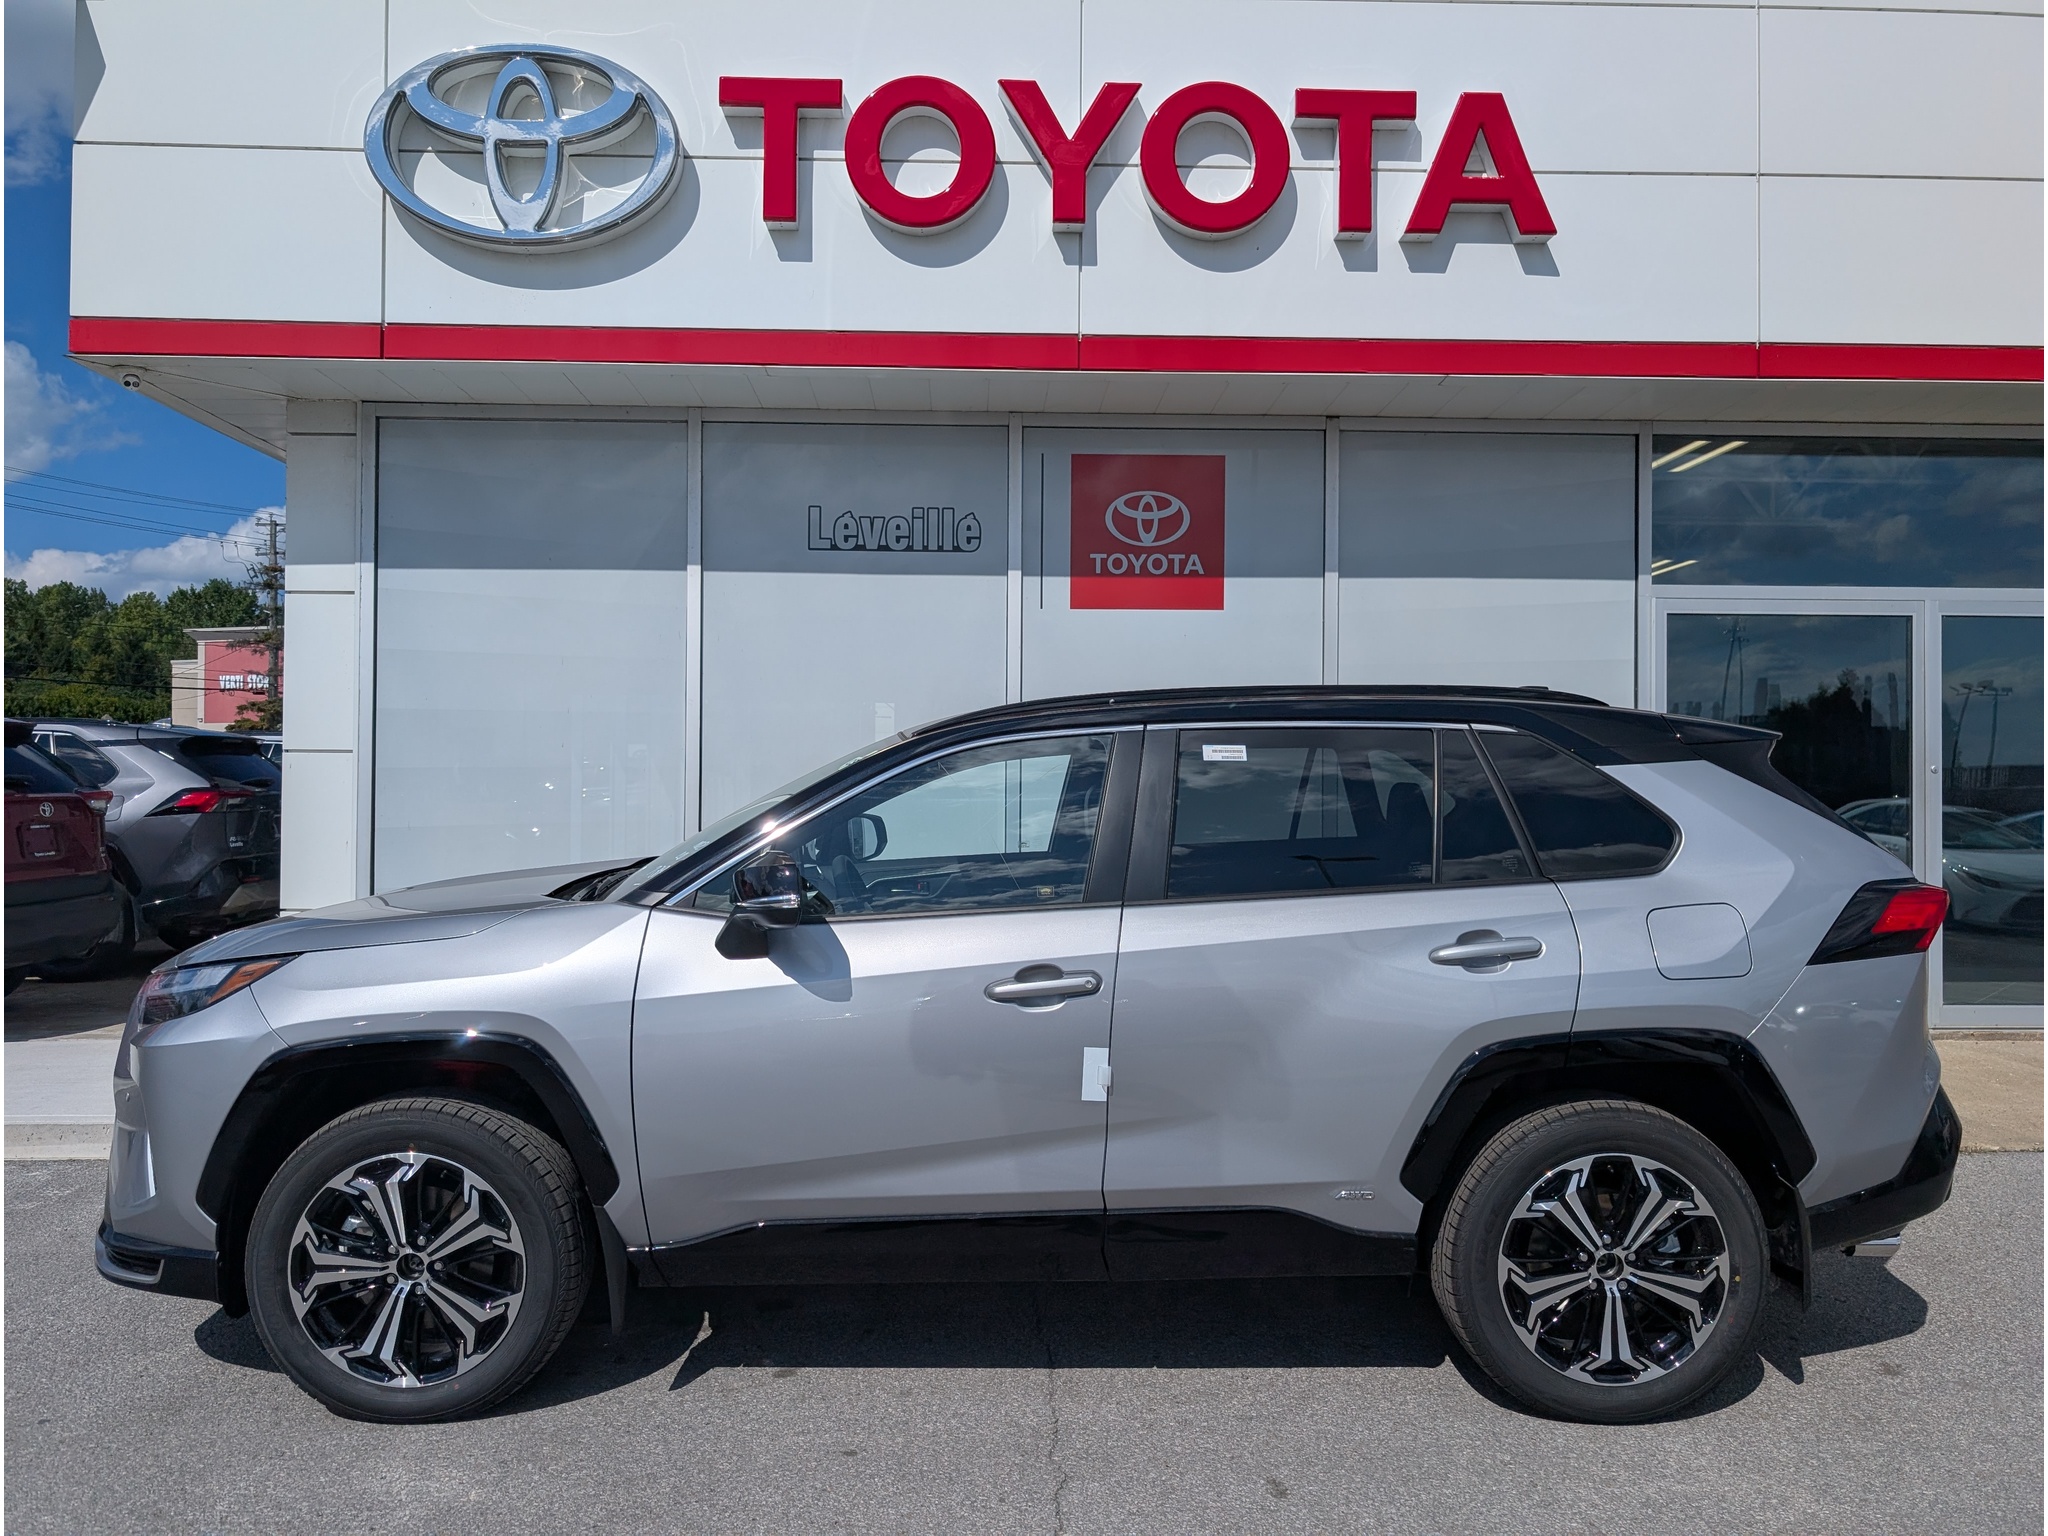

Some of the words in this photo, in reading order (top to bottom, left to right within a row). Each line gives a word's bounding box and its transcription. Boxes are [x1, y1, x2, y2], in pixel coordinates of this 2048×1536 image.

[718, 74, 1558, 243] TOYOTA
[808, 505, 982, 552] Léveillé
[1089, 552, 1205, 576] TOYOTA
[219, 674, 244, 690] VERTI
[1334, 1189, 1376, 1200] AWD
